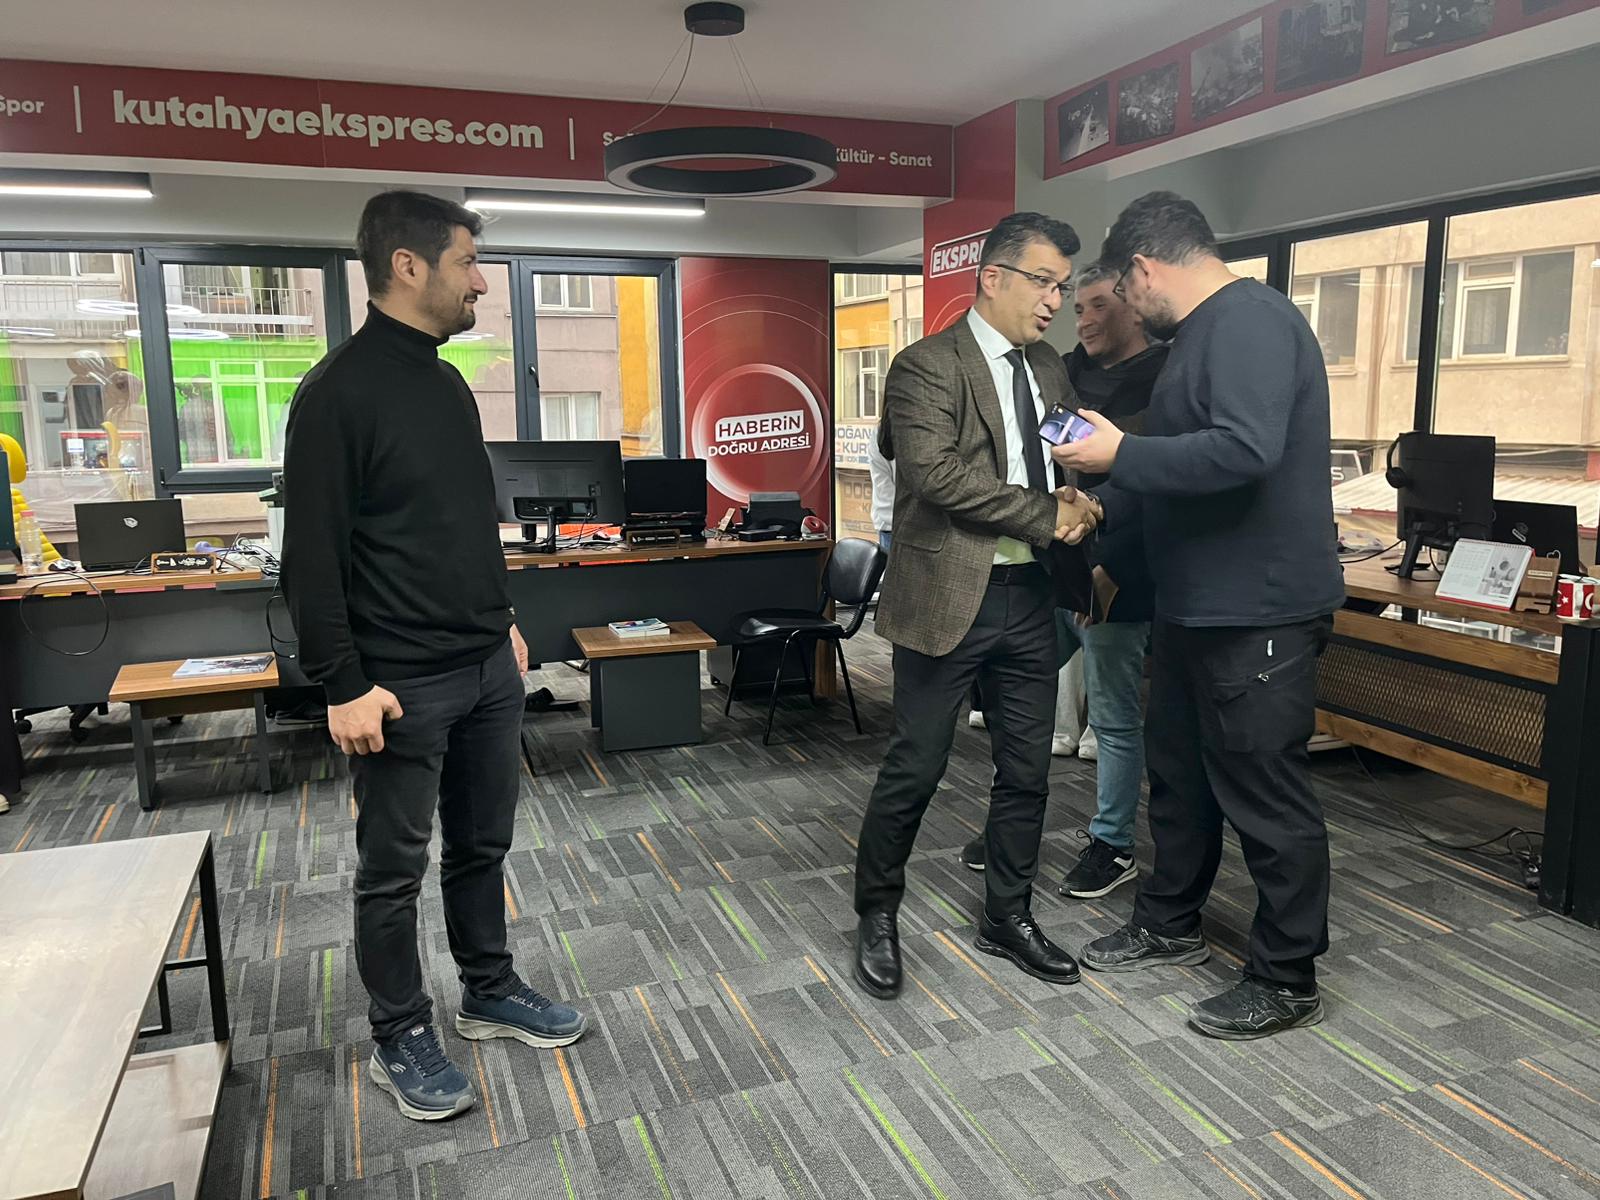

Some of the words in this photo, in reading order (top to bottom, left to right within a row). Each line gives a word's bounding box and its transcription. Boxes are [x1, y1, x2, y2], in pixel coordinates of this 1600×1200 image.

[113, 90, 543, 148] kutahyaekspres.com
[889, 151, 933, 167] Sanat
[708, 441, 758, 457] DOĞRU
[761, 432, 810, 451] ADRESİ
